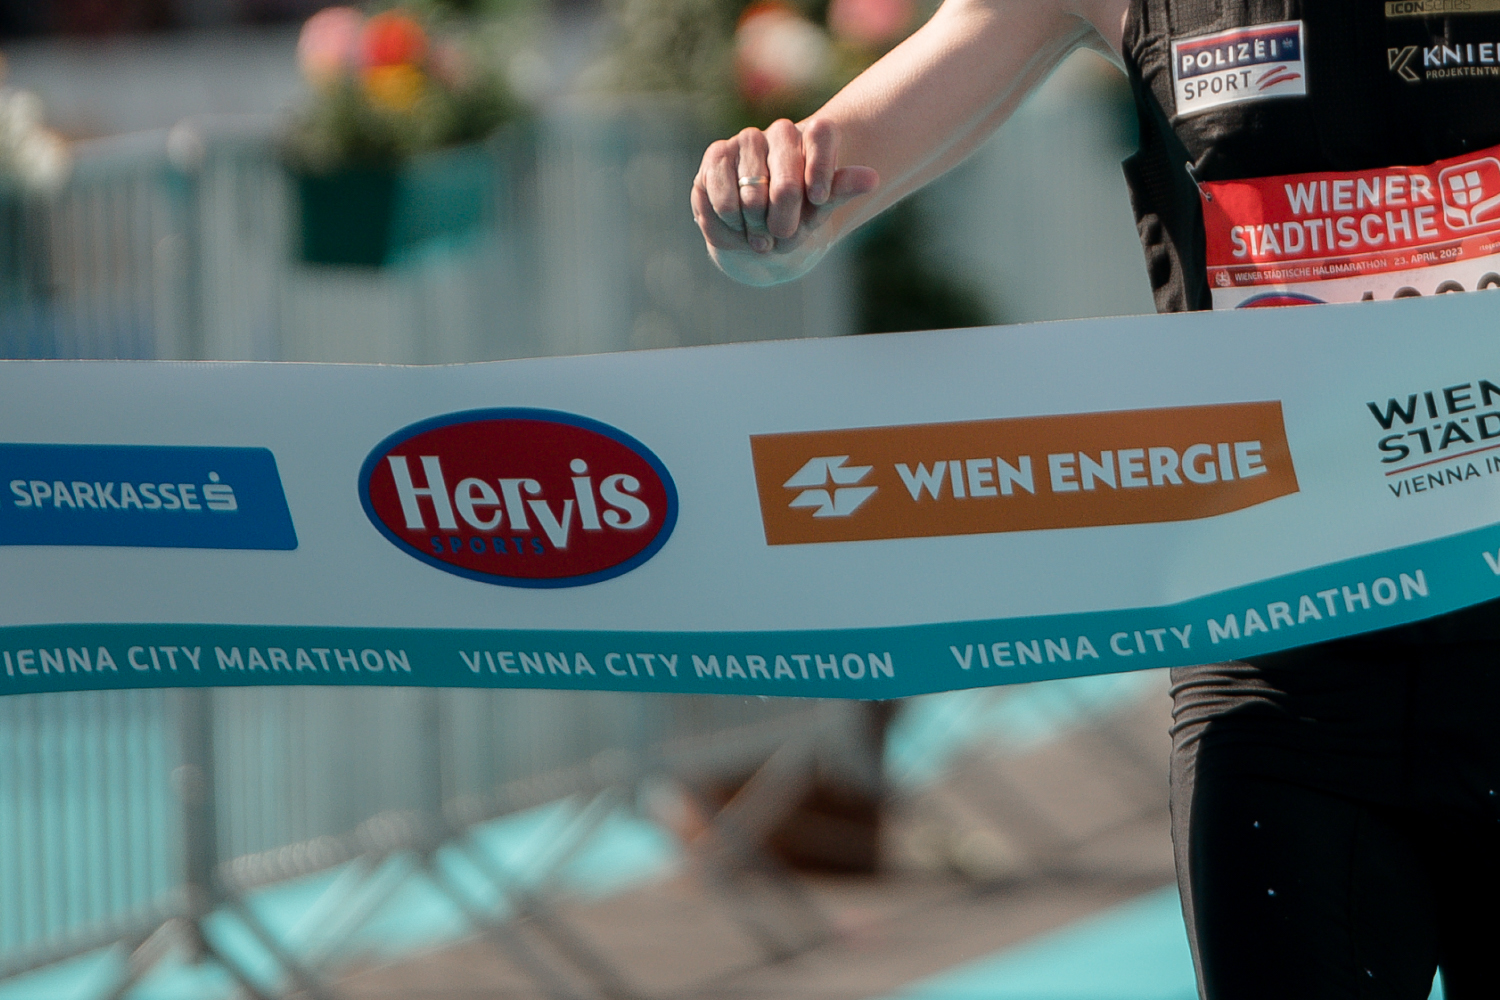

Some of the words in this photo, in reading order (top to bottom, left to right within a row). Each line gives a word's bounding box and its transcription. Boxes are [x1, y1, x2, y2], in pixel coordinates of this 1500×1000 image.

[1181, 38, 1278, 73] POLIZEI
[1183, 69, 1253, 101] SPORT
[1284, 174, 1435, 215] WIENER
[1230, 205, 1439, 258] STÄDTISCHE
[1234, 271, 1264, 282] WIENER
[1263, 266, 1312, 280] STÄDTISCHE
[1312, 259, 1388, 276] HALBMARATHON
[1394, 256, 1409, 266] 23.
[1411, 252, 1439, 264] APRIL
[1440, 246, 1464, 259] 2023
[894, 454, 1035, 502] WIEN
[1047, 439, 1268, 494] ENERGIE
[1388, 462, 1482, 498] VIENNA
[9, 478, 201, 512] SPARKASSE
[386, 455, 651, 549] Hervis
[430, 535, 545, 555] SPORTS
[949, 634, 1100, 671] VIENNA
[1109, 622, 1193, 658] CITY
[1206, 569, 1430, 645] MARATHON
[2, 645, 119, 677] IENNA
[127, 644, 202, 675] CITY
[214, 645, 412, 675] MARATHON
[458, 649, 597, 677] VIENNA
[604, 651, 679, 678] CITY
[691, 651, 895, 680] MARATHON
